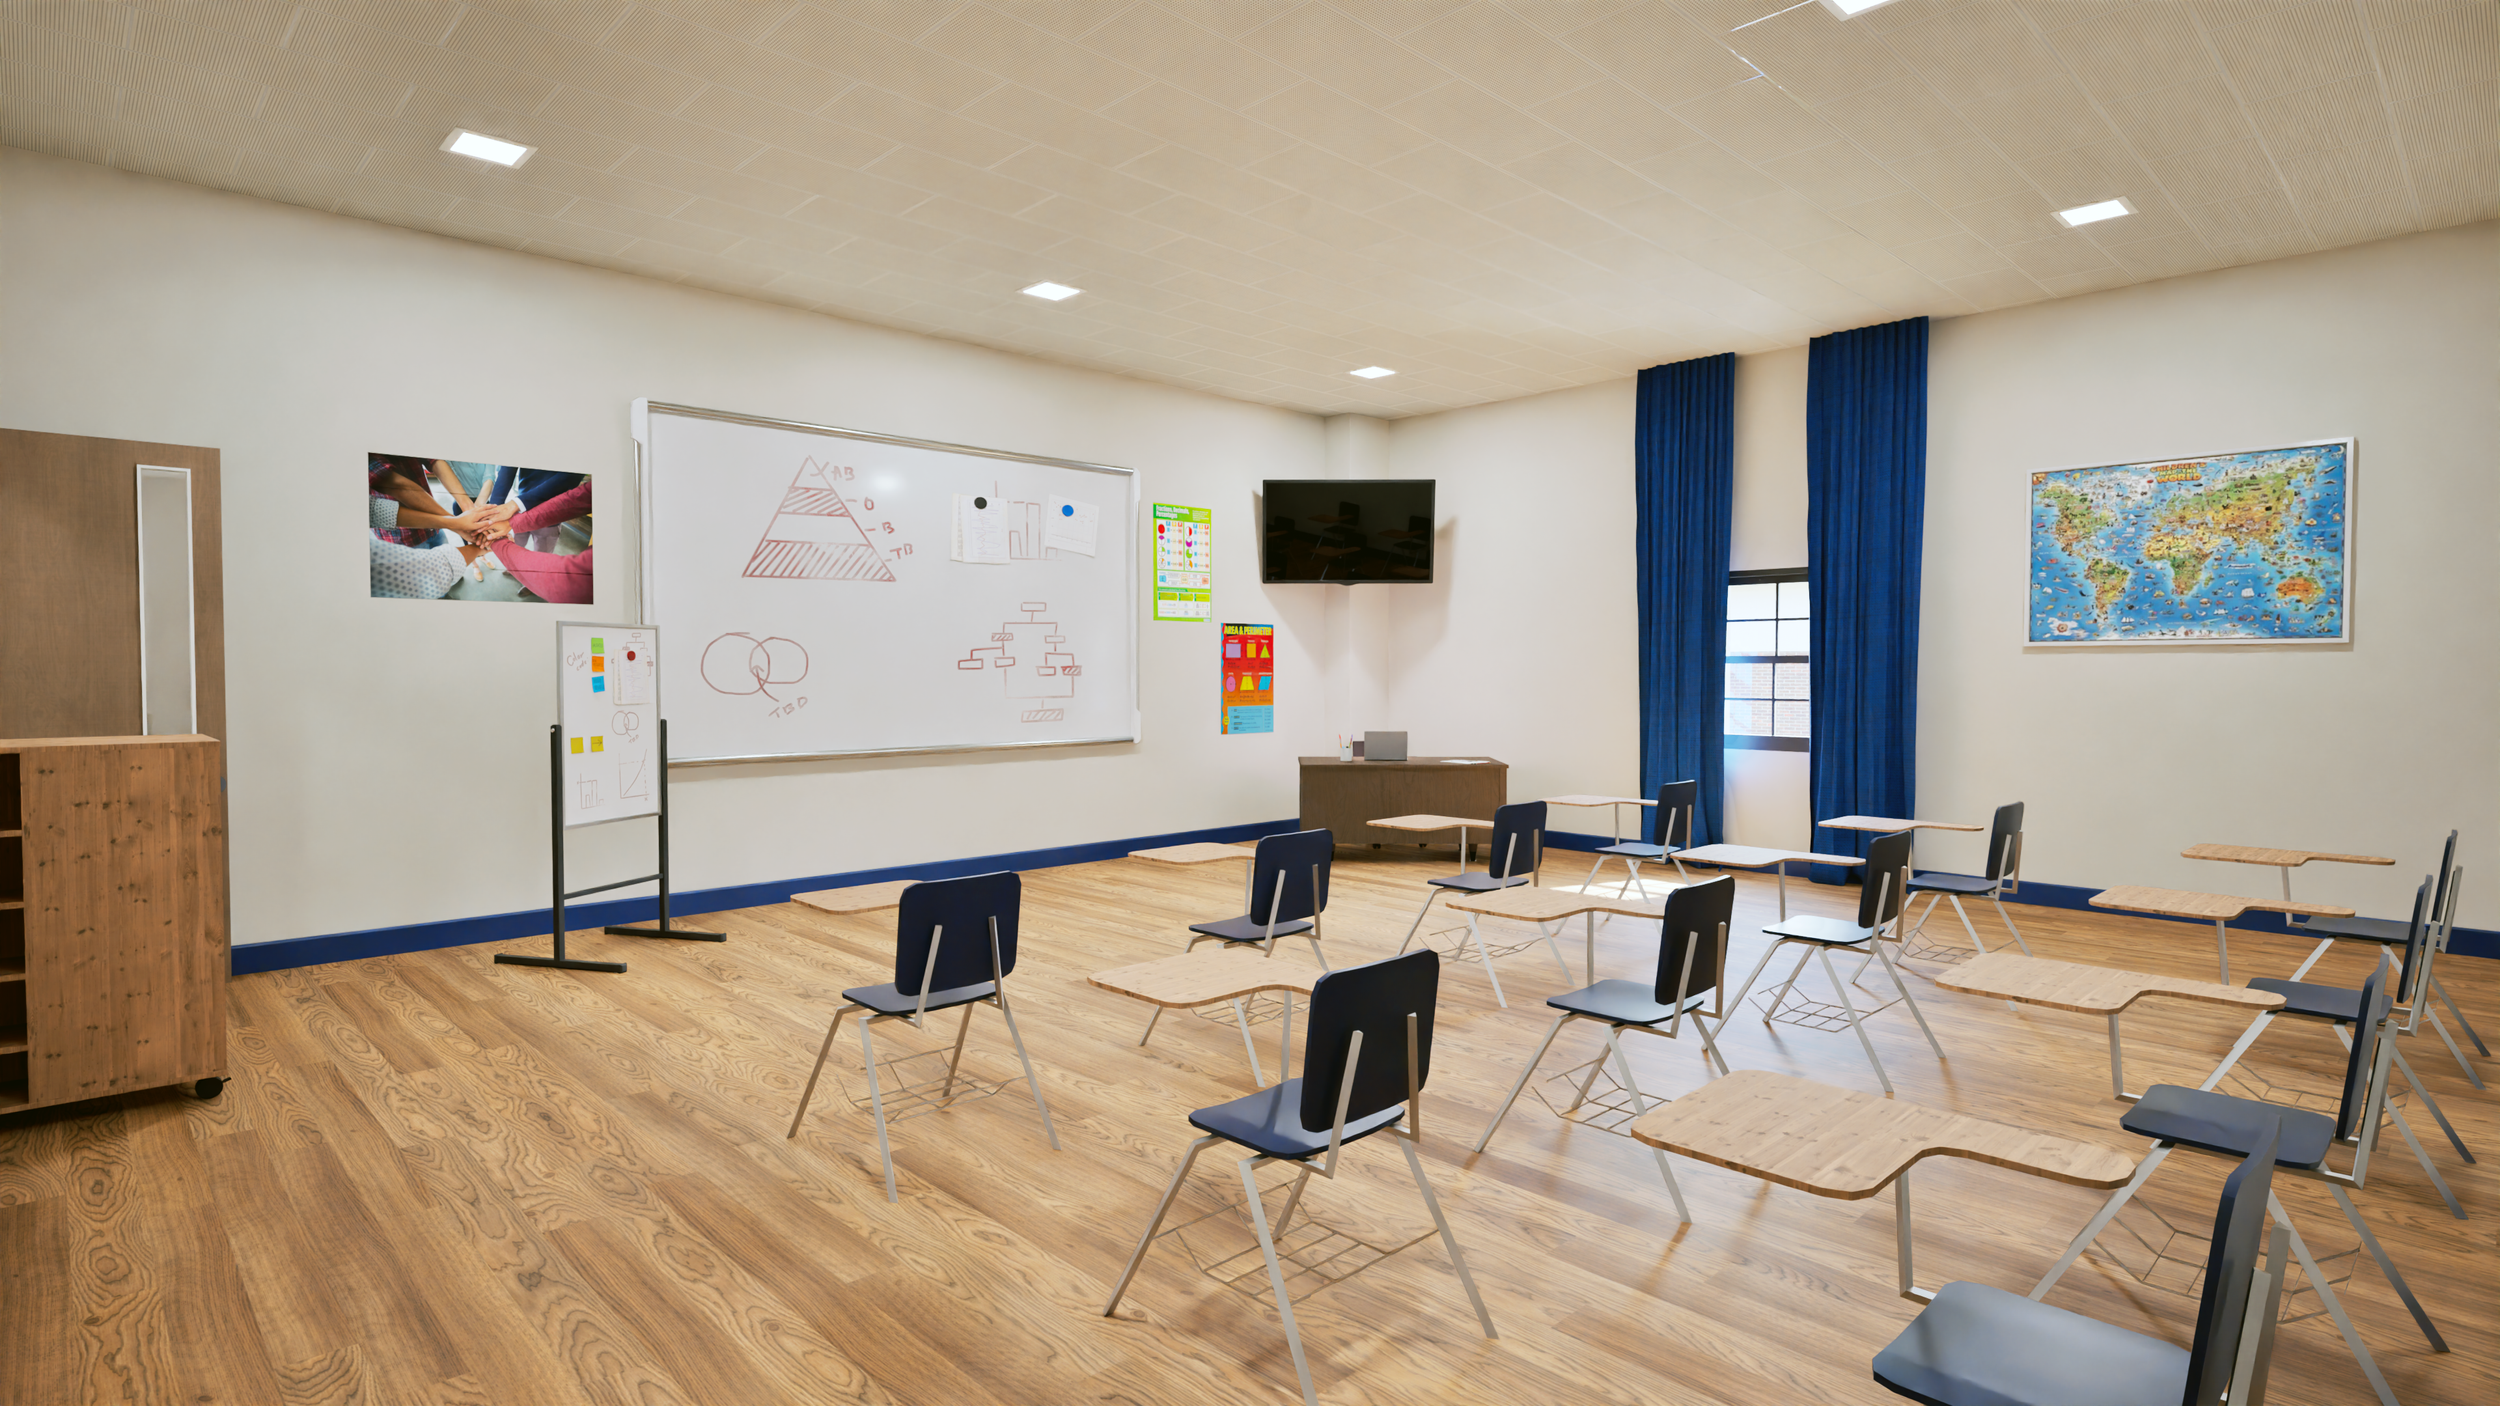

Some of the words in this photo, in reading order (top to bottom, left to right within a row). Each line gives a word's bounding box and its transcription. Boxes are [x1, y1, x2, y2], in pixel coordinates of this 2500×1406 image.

[831, 465, 855, 481] AB
[2150, 462, 2207, 473] CHILDREN'S
[2156, 473, 2202, 484] WORLD
[882, 521, 895, 534] B
[1224, 625, 1239, 635] AREA
[1239, 626, 1244, 635] &
[1244, 626, 1272, 636] PERIMETER
[566, 652, 585, 667] Color
[768, 696, 808, 718] TBD
